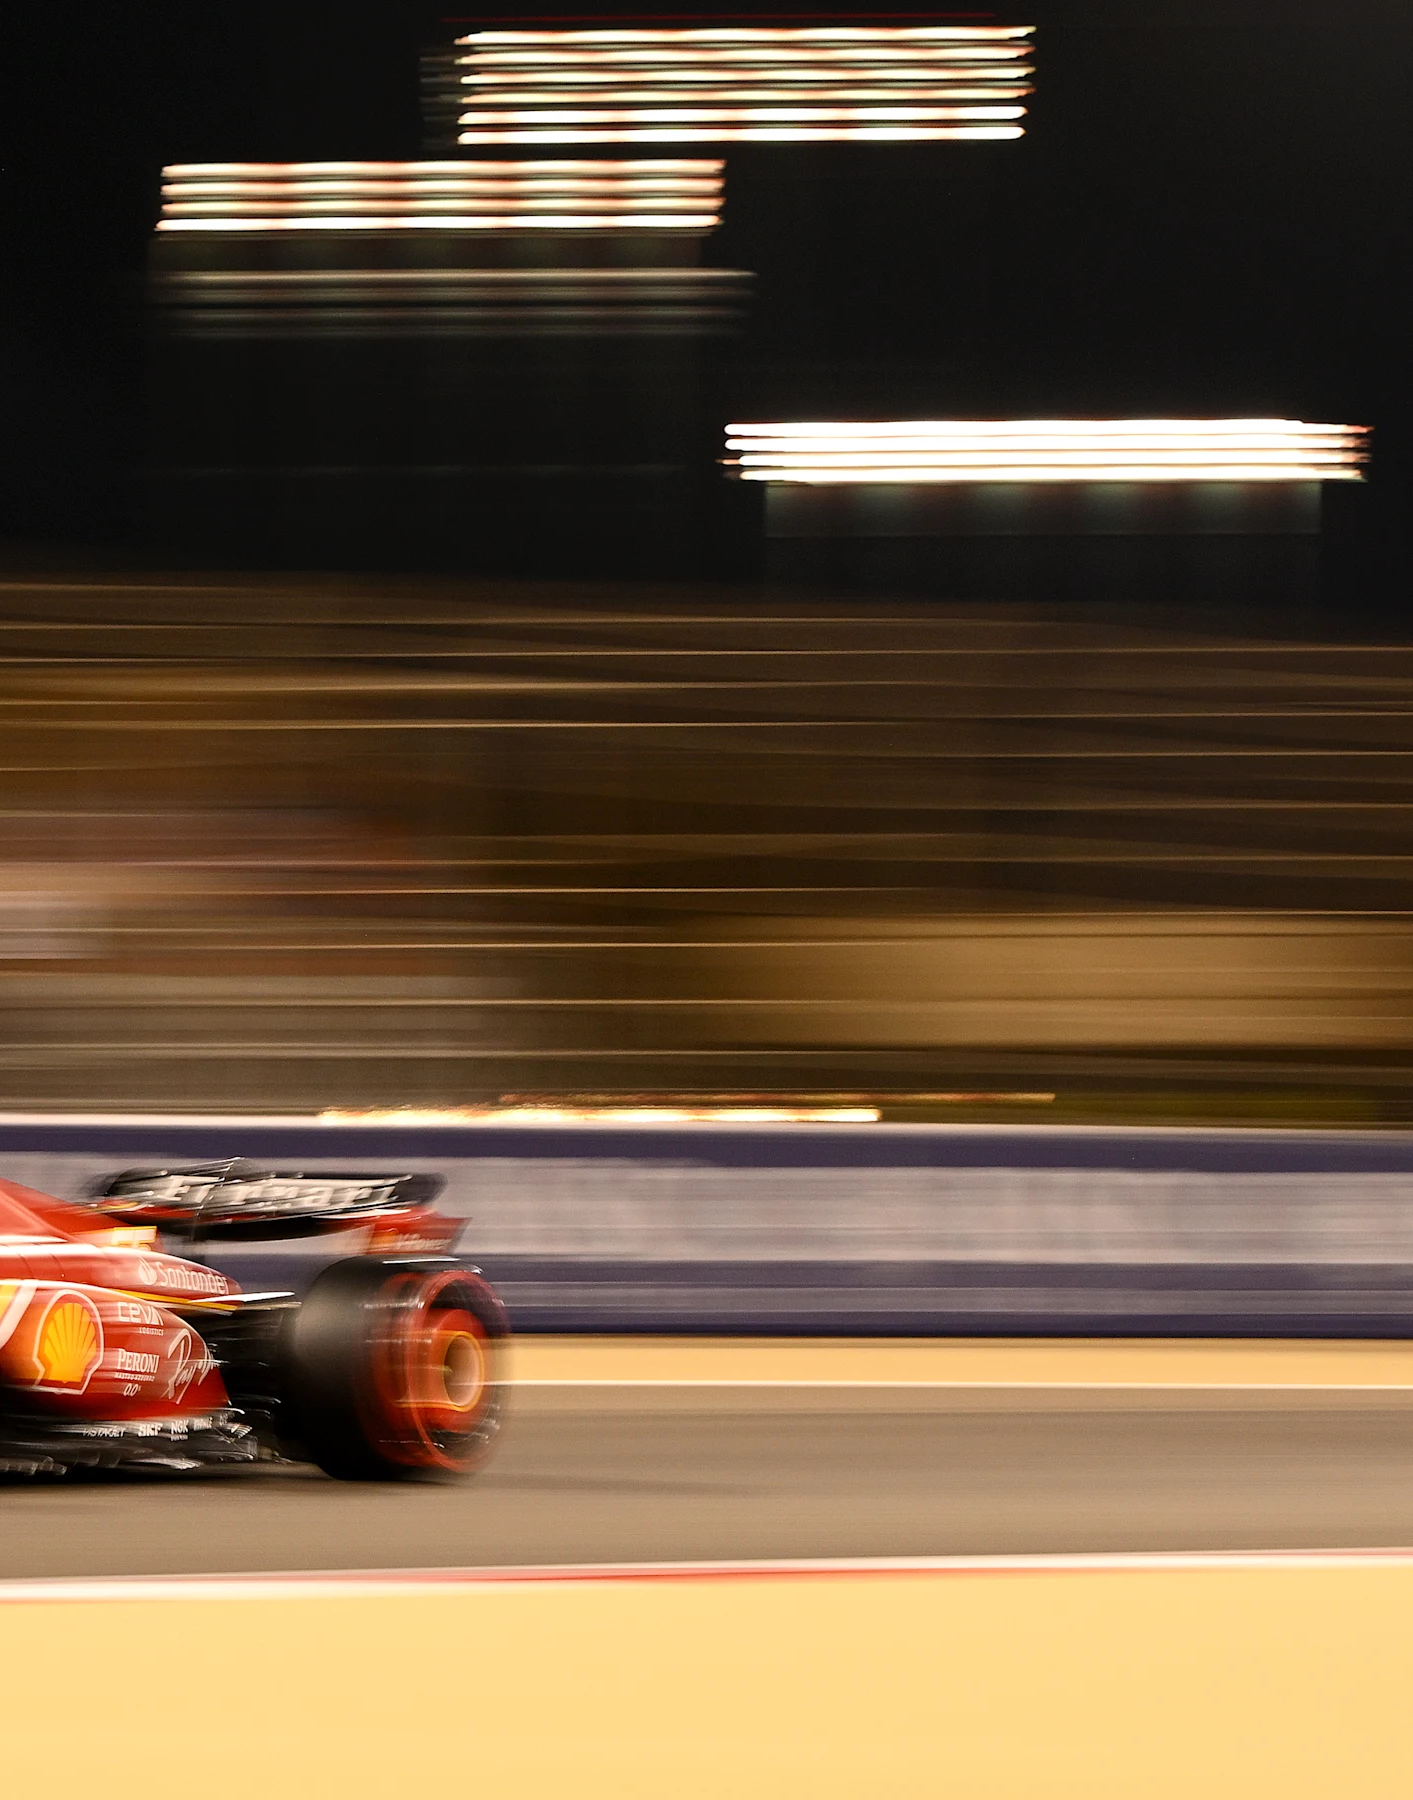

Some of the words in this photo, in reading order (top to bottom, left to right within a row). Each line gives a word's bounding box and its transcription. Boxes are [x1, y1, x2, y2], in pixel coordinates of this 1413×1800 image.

[156, 1262, 229, 1295] Santander
[139, 1326, 164, 1336] LOGISTICS
[116, 1348, 159, 1373] PERONI
[171, 1420, 188, 1435] NGK
